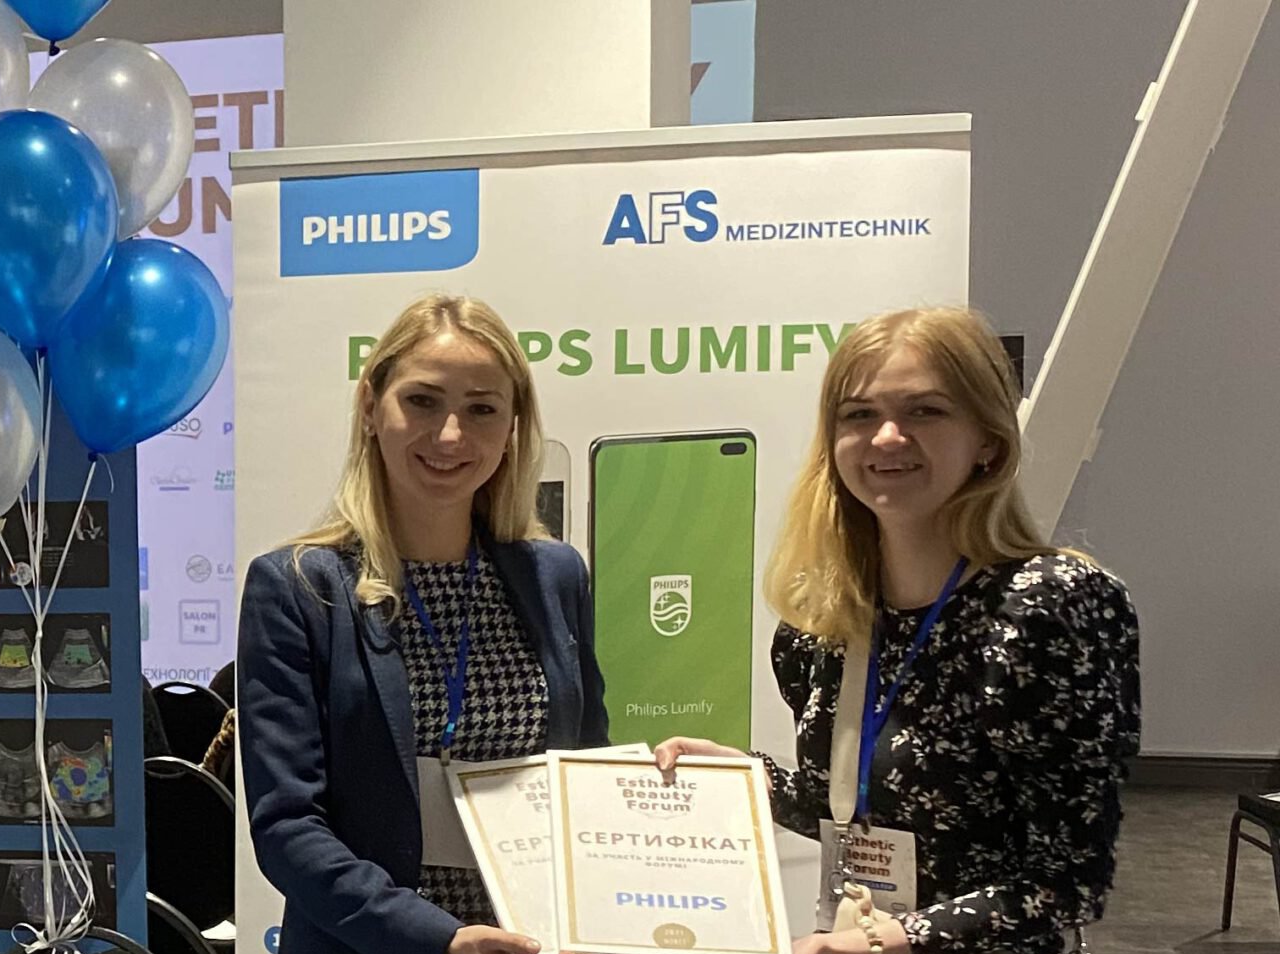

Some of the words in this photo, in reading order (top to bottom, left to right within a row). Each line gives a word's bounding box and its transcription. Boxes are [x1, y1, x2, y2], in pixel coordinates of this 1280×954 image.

[602, 189, 720, 246] AFS
[725, 218, 932, 242] MEDIZINTECHNIK
[302, 210, 452, 245] PHILIPS
[653, 579, 689, 590] PHILIPS
[183, 611, 217, 621] SALON
[143, 667, 211, 681] ЕХНОЛОГІЇ
[626, 702, 668, 717] Philips
[671, 699, 714, 716] Lumify
[622, 788, 693, 802] Beauty
[626, 800, 691, 812] Forum
[577, 831, 752, 851] СЕРТИФІКАТ
[616, 891, 728, 911] PHILIPS
